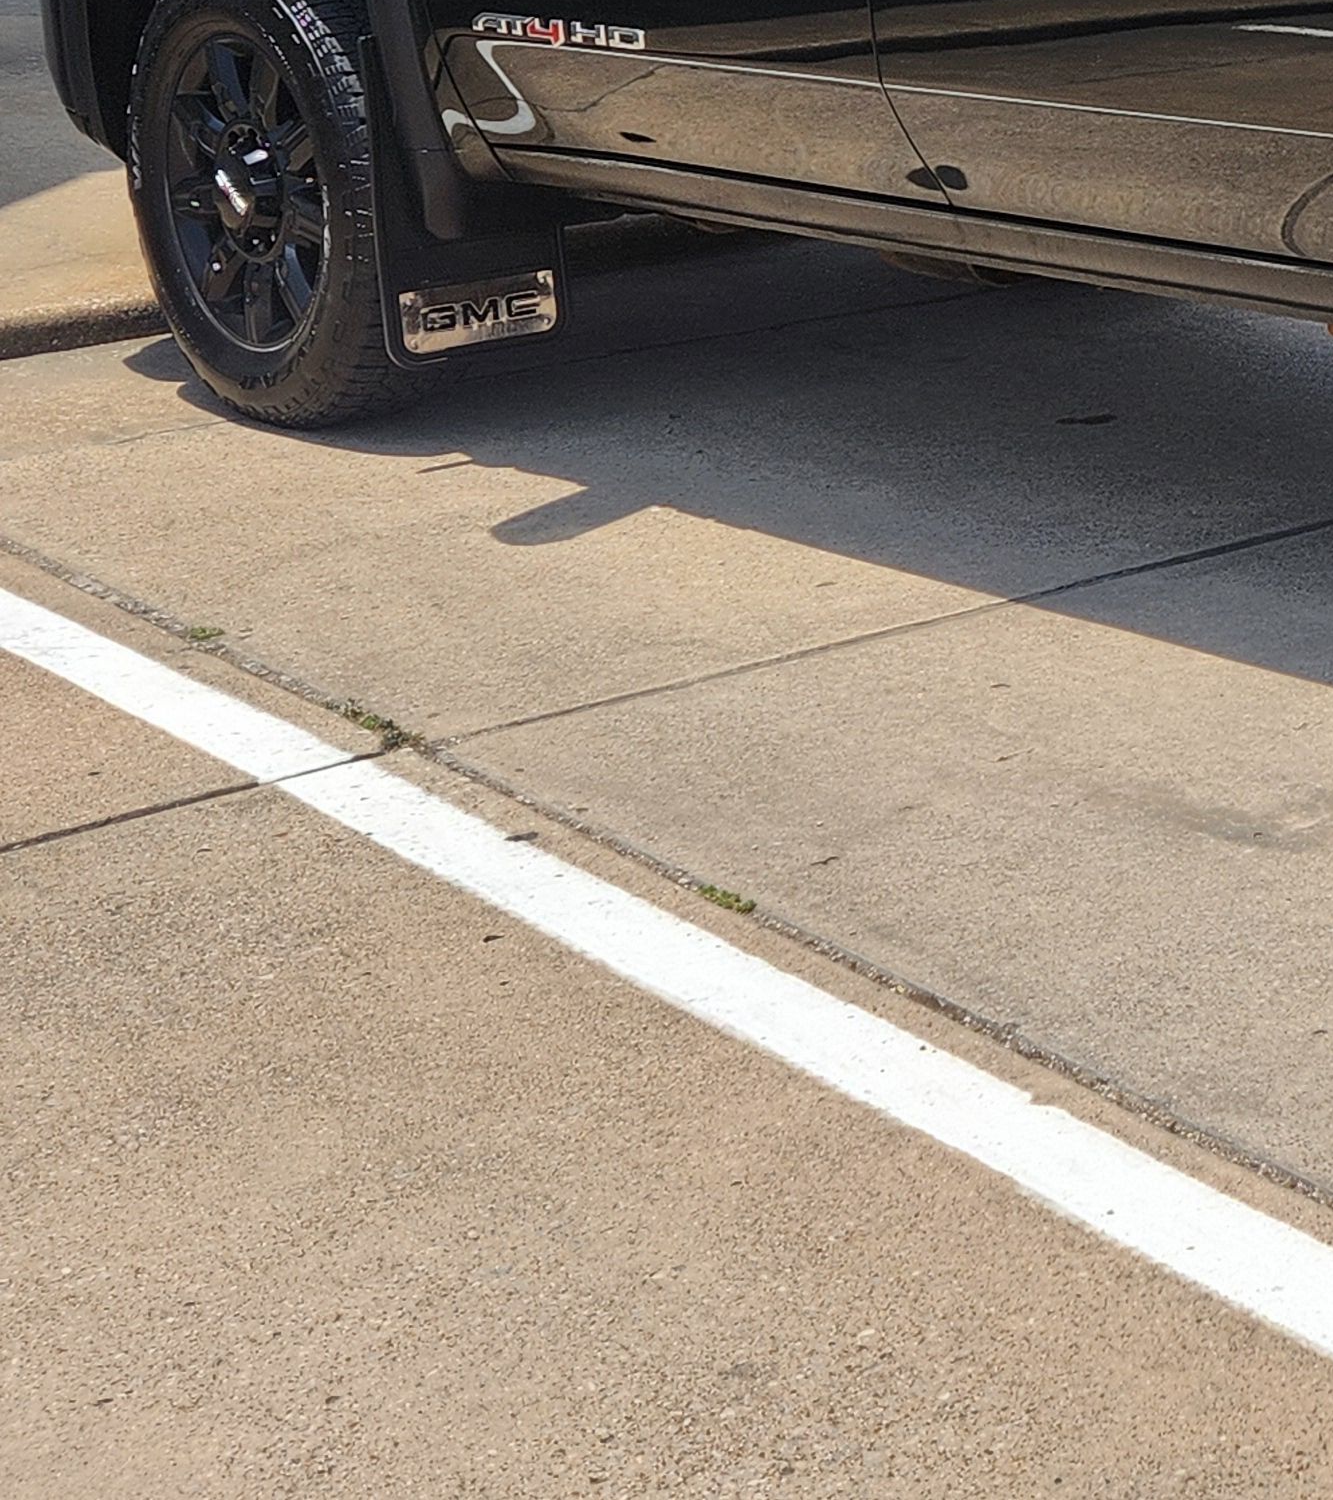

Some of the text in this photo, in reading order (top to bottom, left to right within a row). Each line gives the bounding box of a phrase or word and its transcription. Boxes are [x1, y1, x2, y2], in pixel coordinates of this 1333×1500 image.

[471, 11, 646, 51] AT4 HD
[420, 289, 542, 333] GMC
